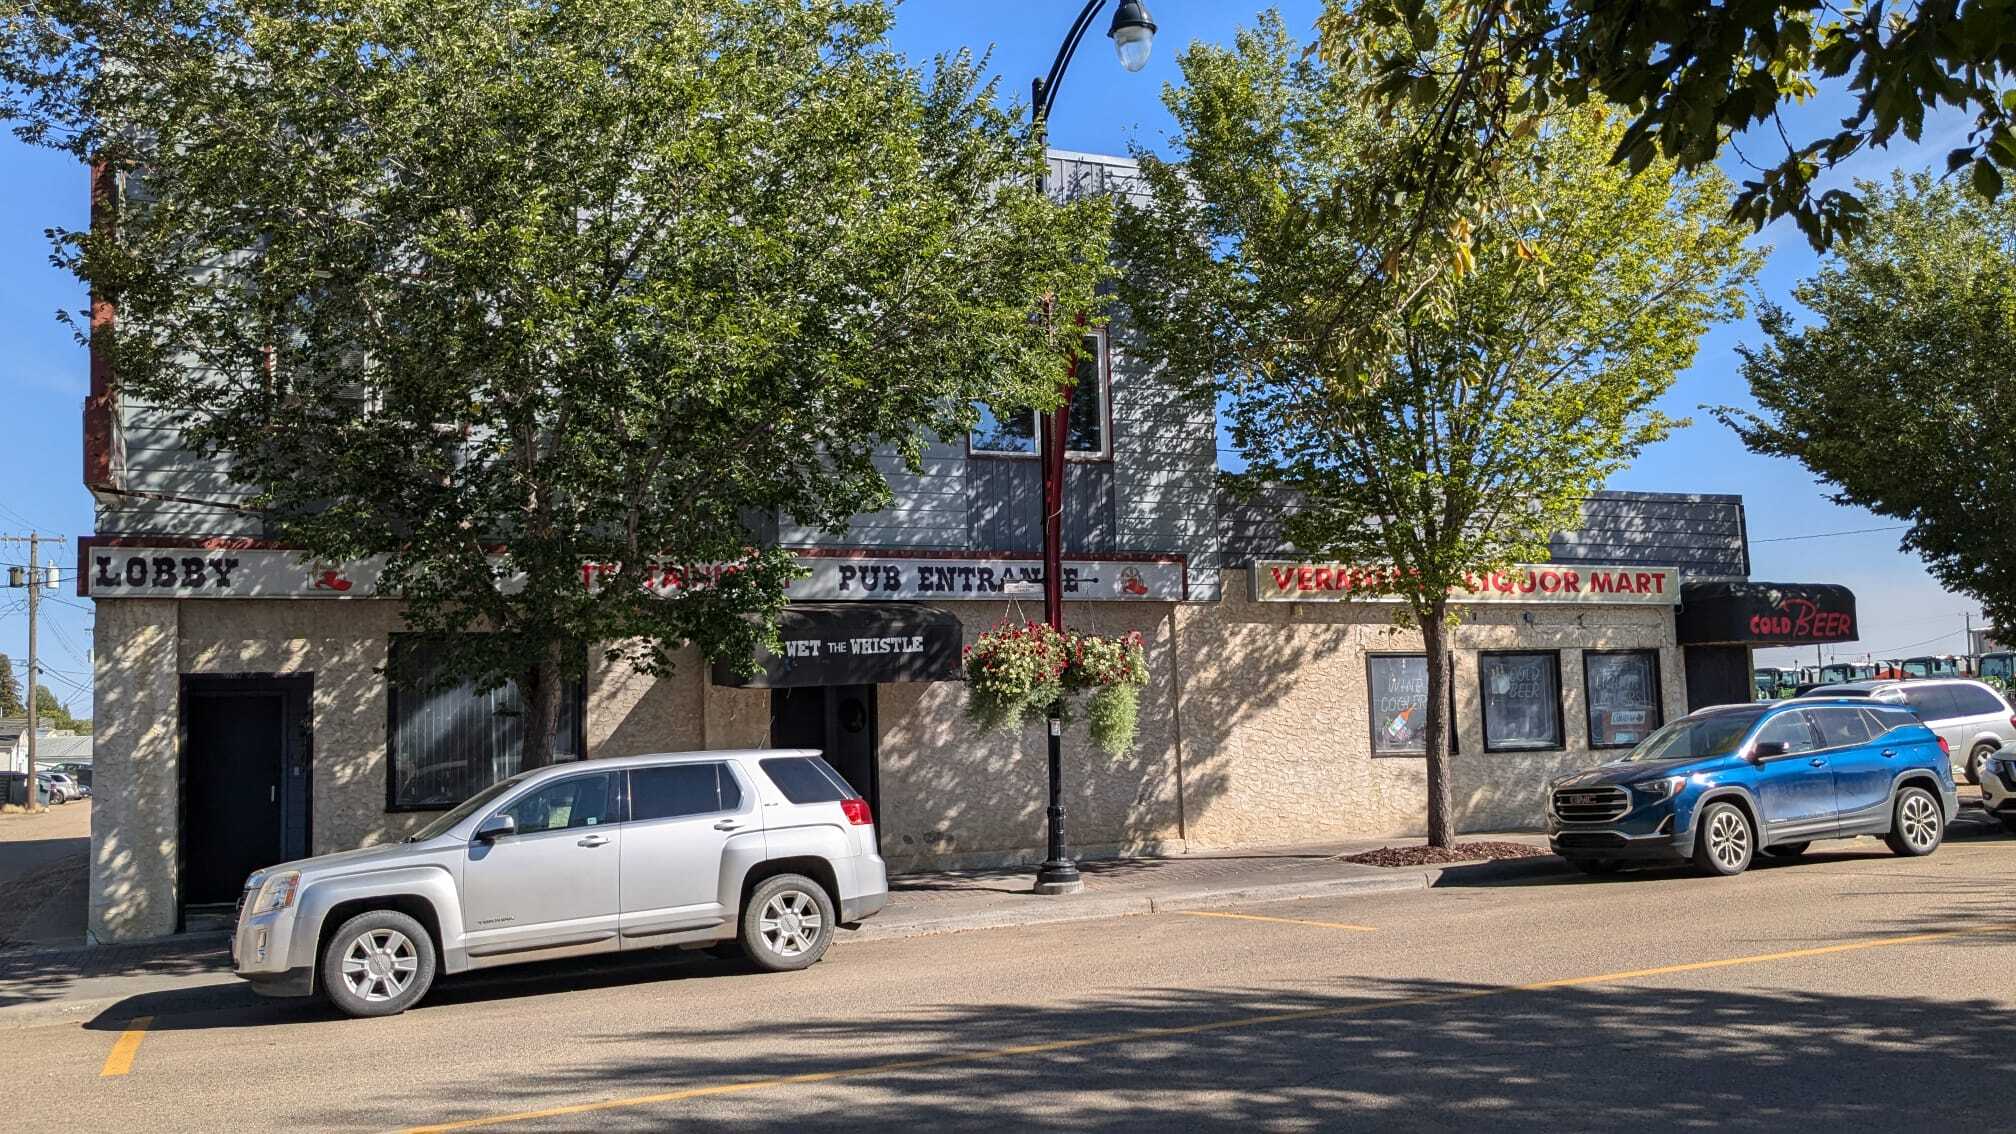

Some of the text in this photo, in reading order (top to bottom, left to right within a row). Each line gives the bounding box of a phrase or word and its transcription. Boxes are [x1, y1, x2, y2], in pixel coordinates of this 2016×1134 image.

[96, 556, 239, 587] LOBBY
[838, 565, 901, 592] PUB
[917, 566, 1079, 593] ENTRANE
[1590, 572, 1666, 593] MART
[1750, 598, 1852, 637] COLD BEER
[785, 636, 924, 657] WET THE WHISTLE
[1508, 682, 1541, 698] BEER
